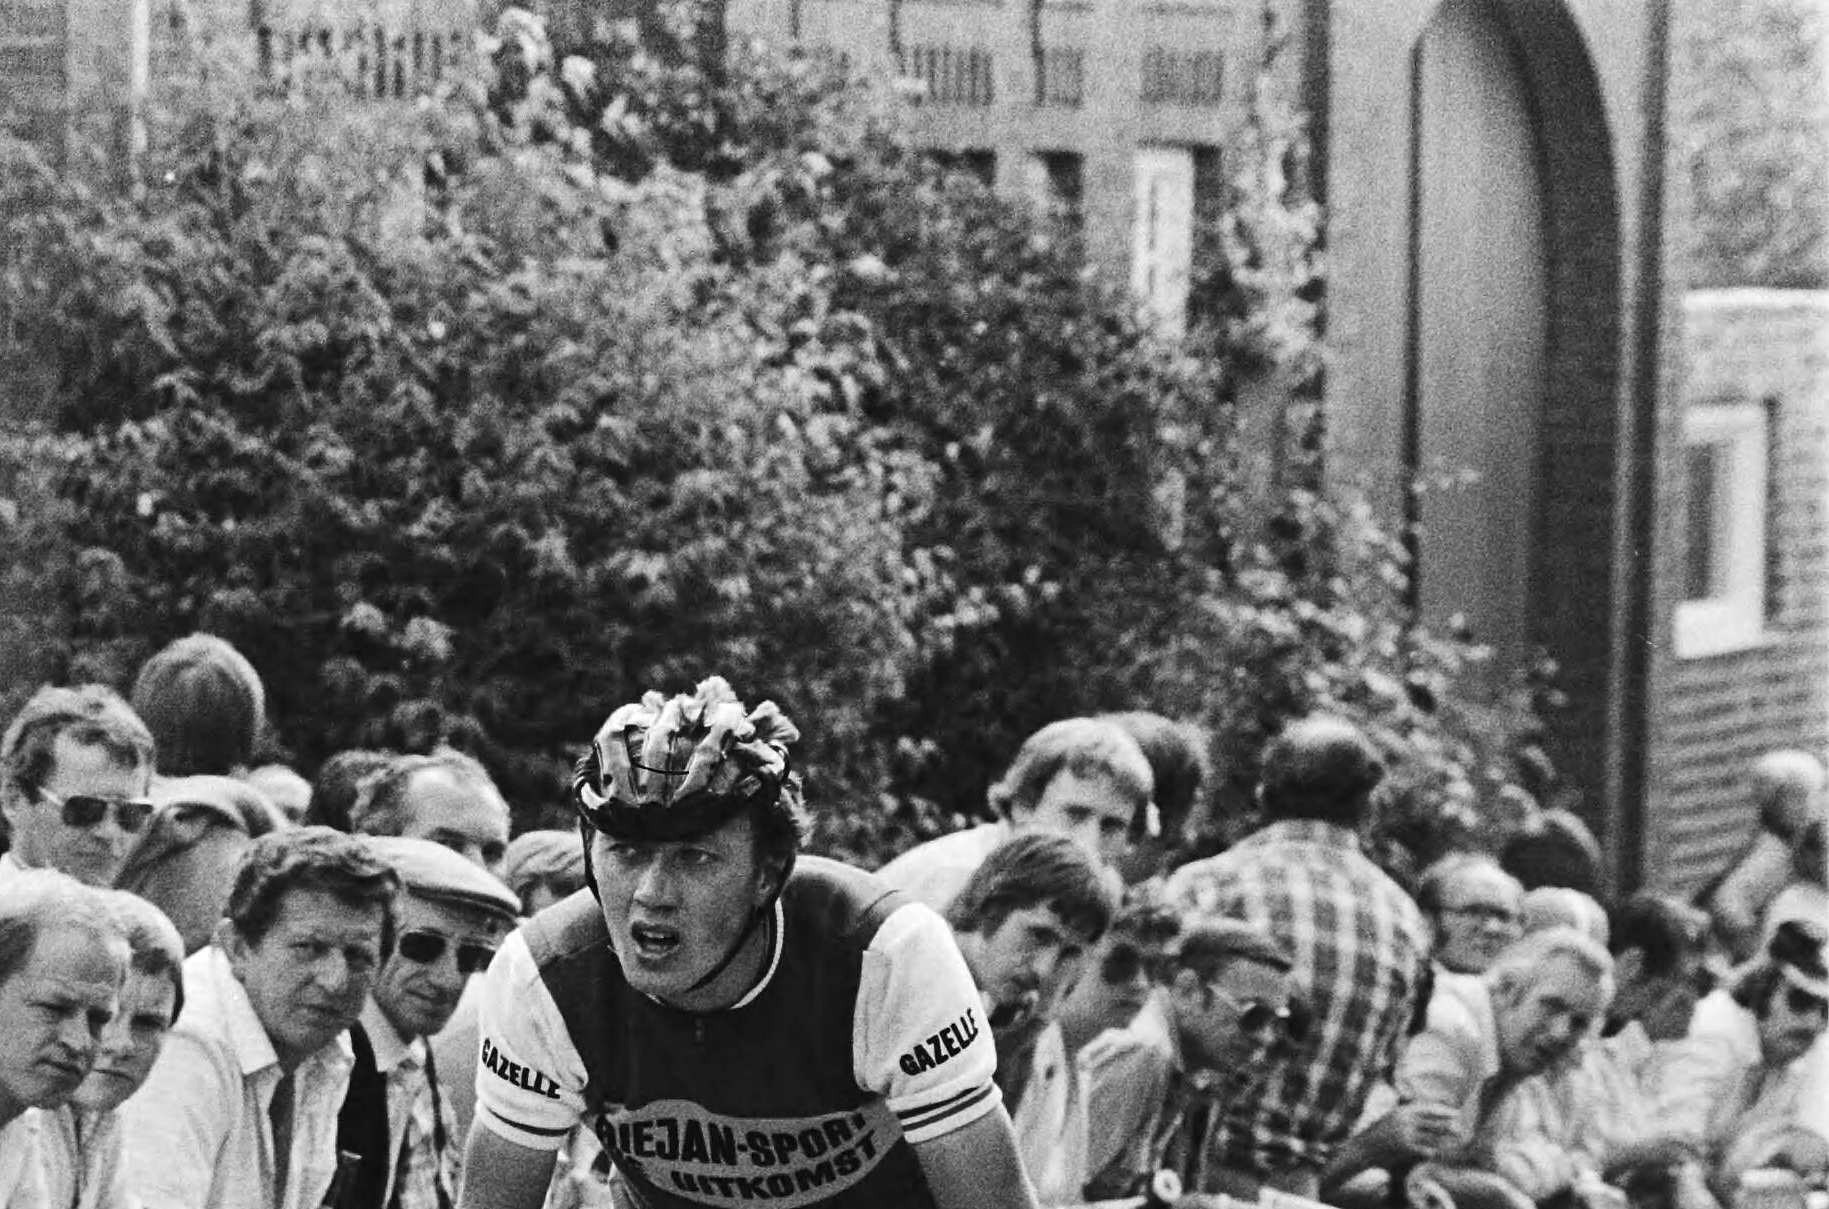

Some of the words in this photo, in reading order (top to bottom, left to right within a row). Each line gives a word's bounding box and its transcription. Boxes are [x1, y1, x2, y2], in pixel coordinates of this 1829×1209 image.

[482, 1037, 561, 1100] GAZELLE
[898, 1007, 979, 1076] GAZELLE
[672, 1129, 876, 1200] UITKOMST
